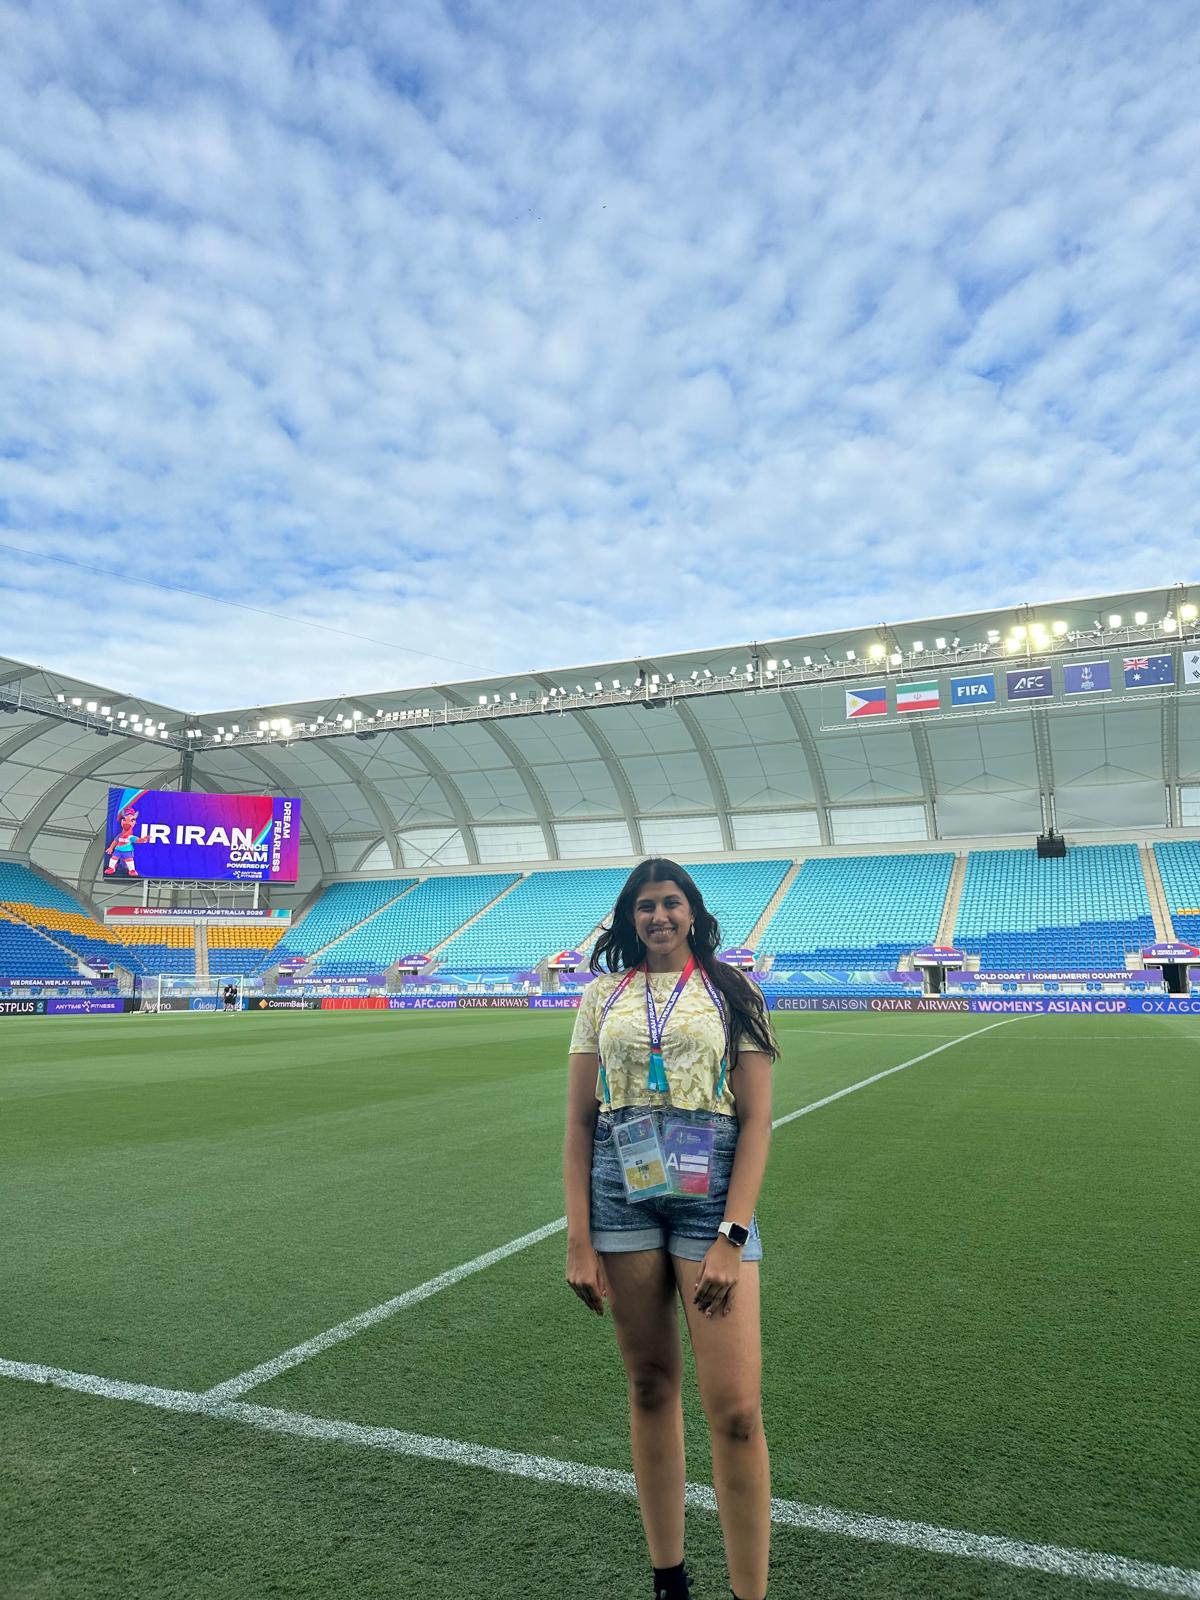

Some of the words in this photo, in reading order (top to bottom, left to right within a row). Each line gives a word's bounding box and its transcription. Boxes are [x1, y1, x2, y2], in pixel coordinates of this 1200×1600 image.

[1014, 675, 1045, 690] AFC
[957, 684, 988, 697] FIFA
[282, 801, 292, 839] DREAM
[141, 824, 171, 844] IR
[176, 825, 253, 848] IRAN
[231, 844, 269, 852] DANCE
[271, 820, 282, 872] FEARLESS
[230, 851, 268, 862] CAM
[1091, 972, 1133, 980] COUNTRY
[458, 997, 488, 1008] QATAR
[491, 997, 529, 1008] AIRWAYS
[535, 998, 570, 1008] KELME
[777, 998, 819, 1010] CREDIT
[821, 998, 868, 1010] SAISON
[871, 999, 912, 1011] QATAR
[917, 999, 970, 1011] AIRWAYS
[978, 1001, 1043, 1012] WOMEN'S
[1047, 1001, 1093, 1012] ASIAN
[1095, 1001, 1126, 1013] CUP
[650, 1020, 659, 1043] DREAM
[665, 1152, 679, 1171] A
